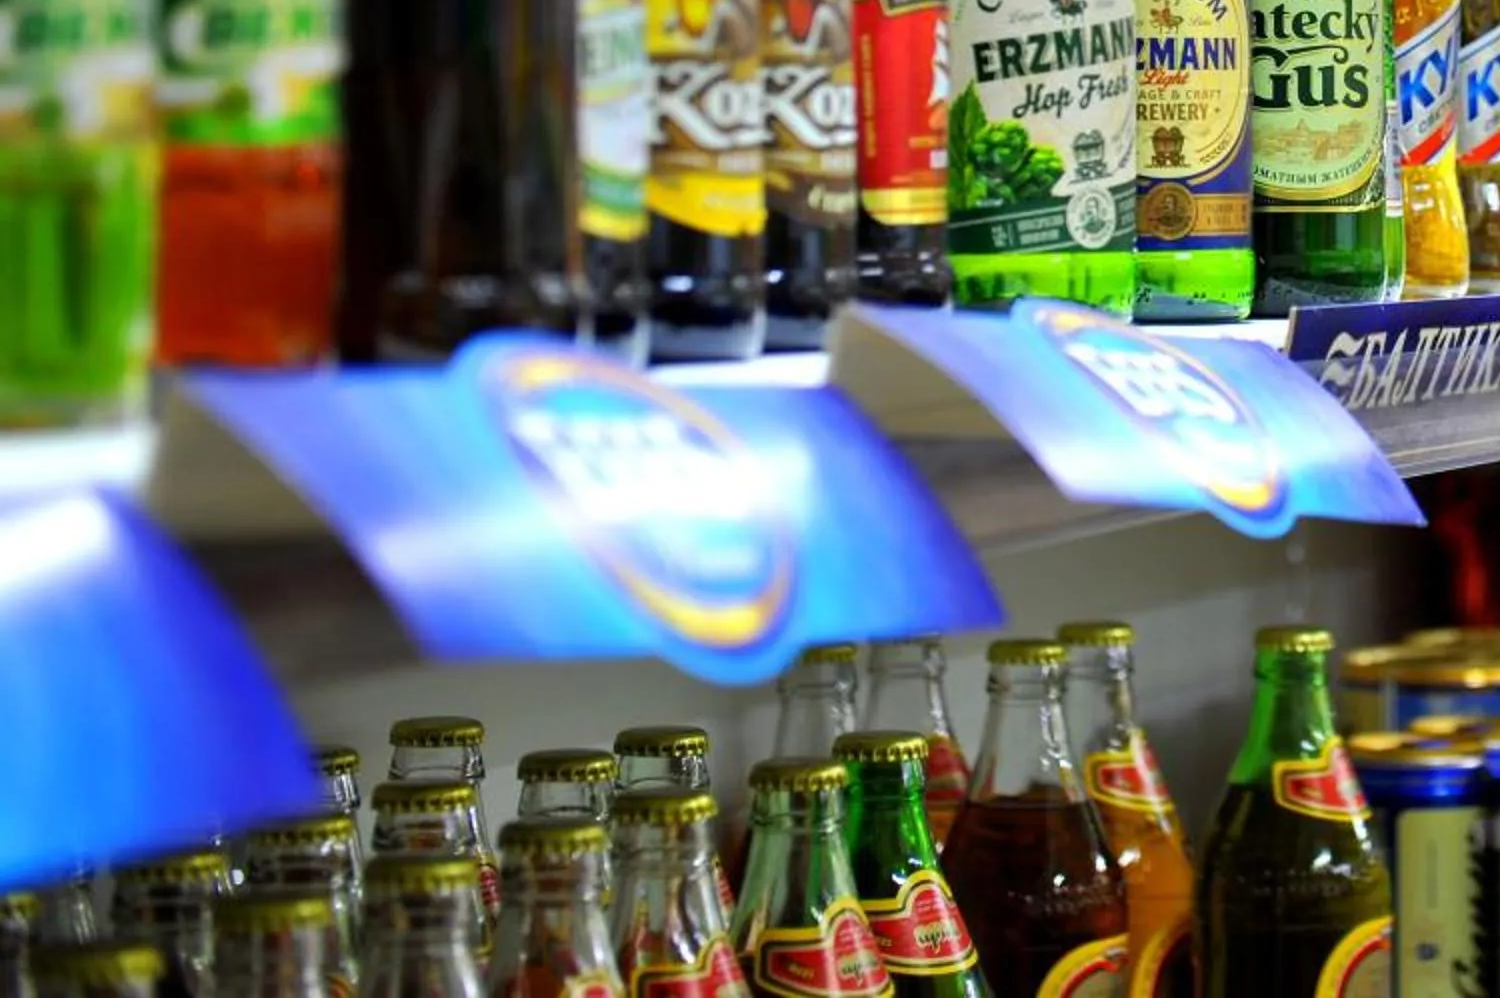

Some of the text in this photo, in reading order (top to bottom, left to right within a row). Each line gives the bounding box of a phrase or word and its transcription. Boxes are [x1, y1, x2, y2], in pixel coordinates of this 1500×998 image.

[1136, 37, 1238, 70] ZMANN
[1013, 64, 1130, 118] Hop Fresh
[1138, 68, 1189, 89] Light
[1252, 44, 1370, 109] Gus
[1399, 35, 1453, 126] КУ
[1138, 89, 1166, 101] AGE
[1185, 89, 1222, 101] CRAFT
[1136, 103, 1209, 121] REWERY
